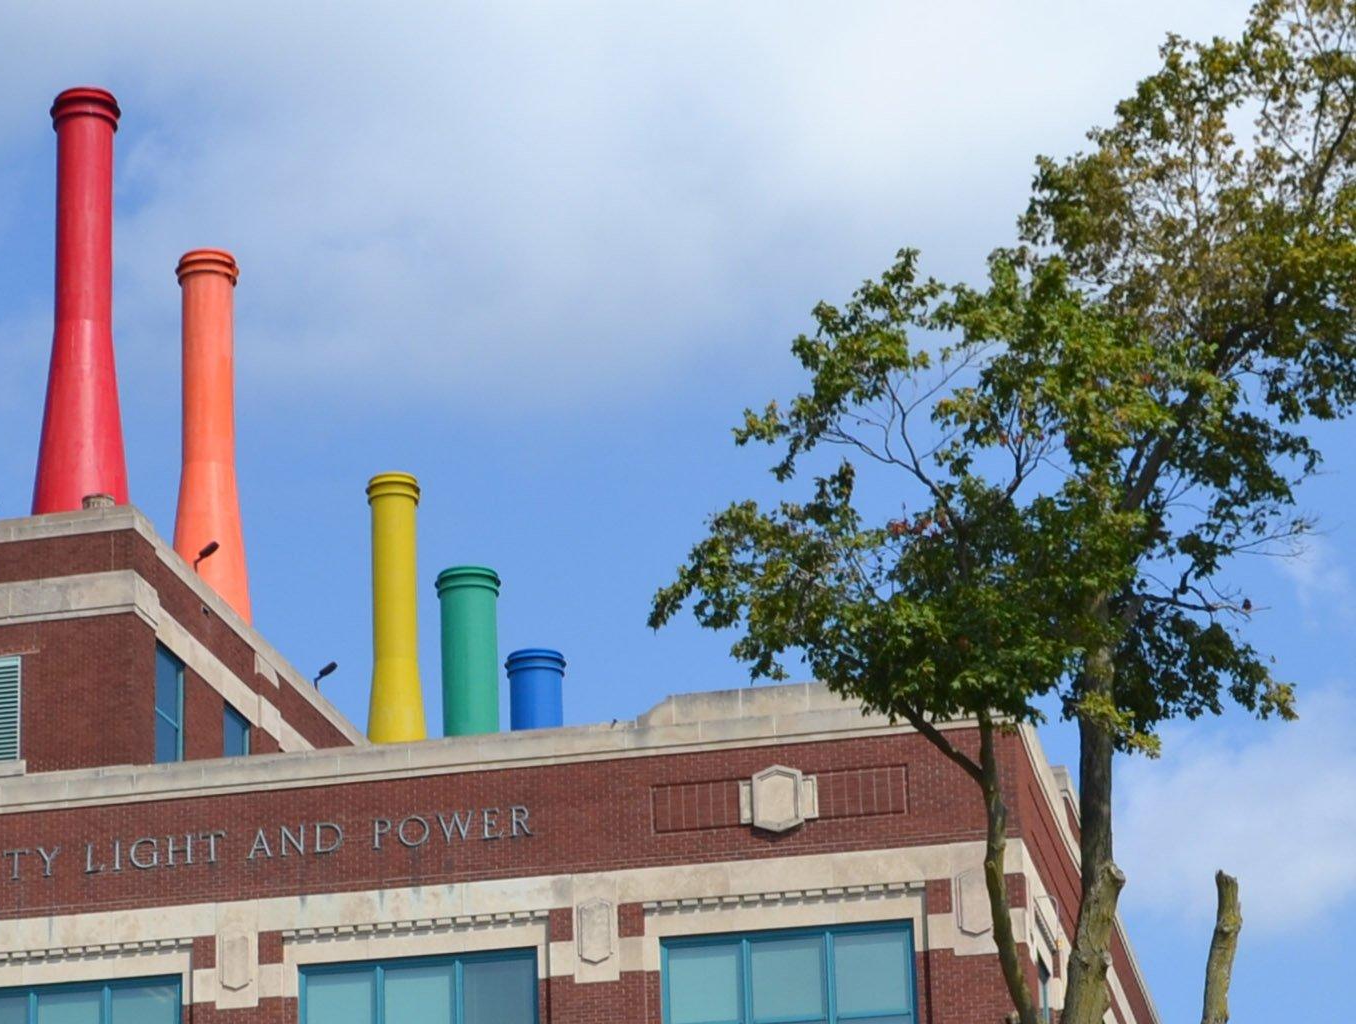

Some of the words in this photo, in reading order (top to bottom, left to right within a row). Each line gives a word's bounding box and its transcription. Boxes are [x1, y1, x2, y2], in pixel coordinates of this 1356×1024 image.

[84, 830, 228, 875] LIGHT
[246, 822, 345, 860] AND
[372, 804, 534, 851] POWER
